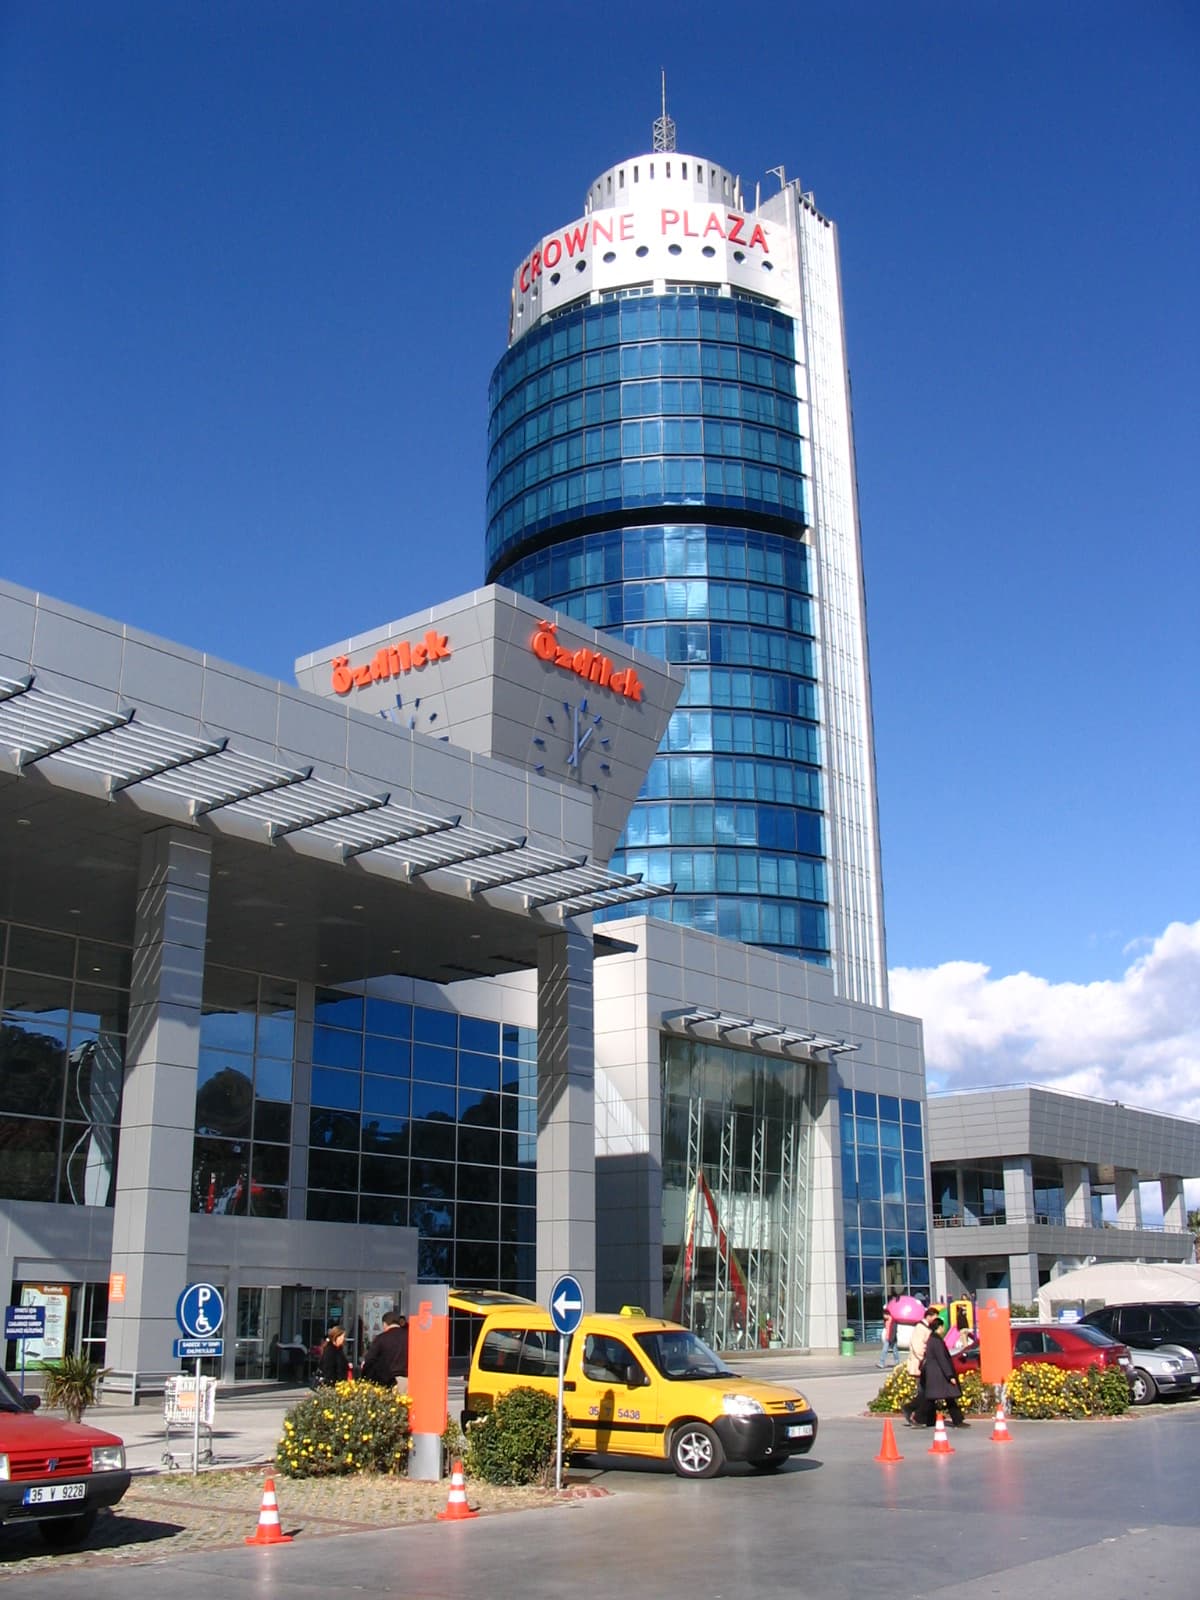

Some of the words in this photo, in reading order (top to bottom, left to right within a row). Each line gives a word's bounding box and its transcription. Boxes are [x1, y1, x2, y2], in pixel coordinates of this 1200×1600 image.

[519, 212, 635, 293] CROWNE
[660, 208, 769, 253] PLAZA
[331, 630, 452, 695] Özdilek
[532, 620, 645, 702] Özdilek
[199, 1287, 211, 1307] P
[31, 1487, 43, 1502] 35
[50, 1487, 56, 1500] V
[62, 1485, 84, 1499] 9228
